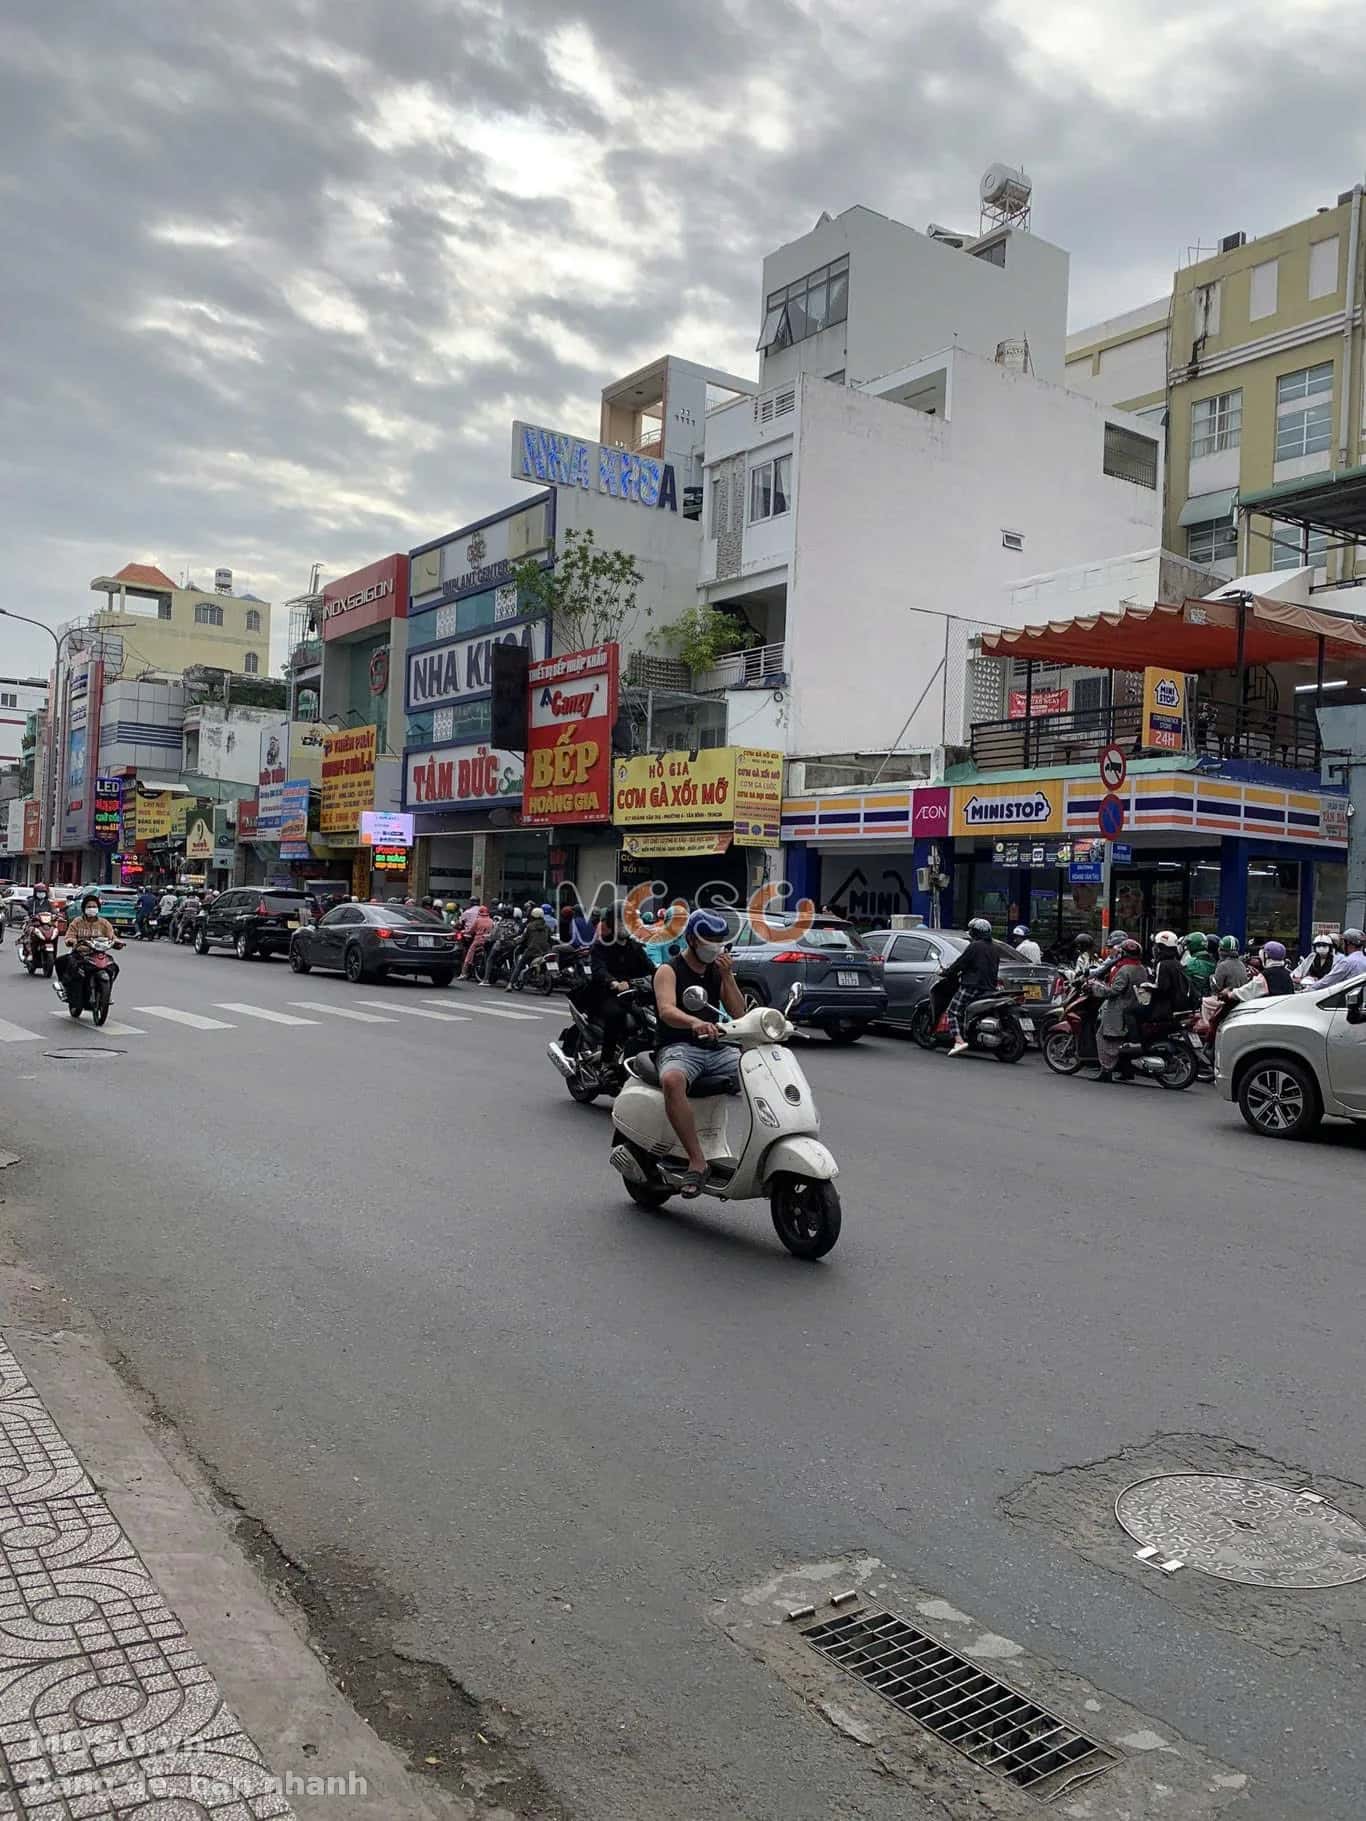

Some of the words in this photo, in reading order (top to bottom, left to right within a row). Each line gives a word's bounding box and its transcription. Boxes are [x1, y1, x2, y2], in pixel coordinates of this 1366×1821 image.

[413, 650, 459, 701] NHA
[1160, 686, 1175, 695] MINI
[1155, 731, 1175, 747] 24H
[531, 724, 599, 788] BẾP
[413, 755, 454, 802] TÂM
[669, 762, 689, 777] GIA
[96, 780, 119, 793] LED
[617, 787, 646, 809] CƠM
[650, 781, 669, 808] GÀ
[670, 778, 699, 807] XỐI
[701, 777, 729, 805] MỠ
[529, 790, 574, 814] HOÀNG
[574, 792, 600, 811] GIA
[971, 800, 1044, 820] MINISTOP
